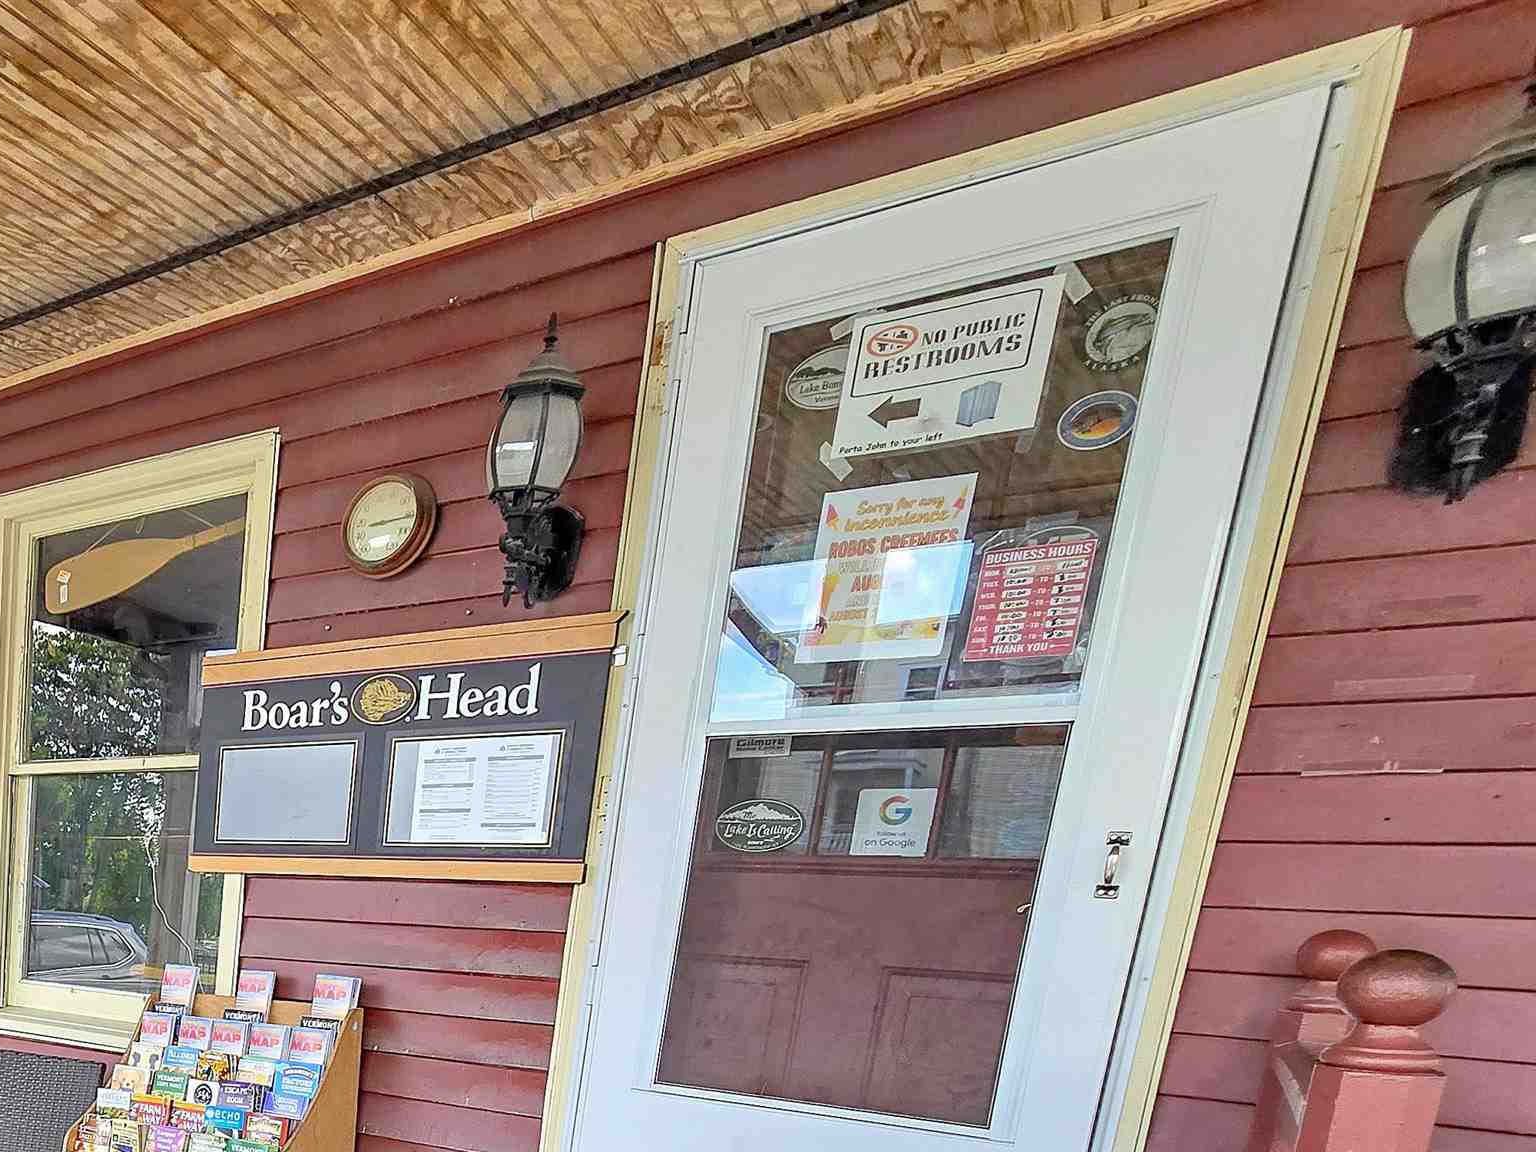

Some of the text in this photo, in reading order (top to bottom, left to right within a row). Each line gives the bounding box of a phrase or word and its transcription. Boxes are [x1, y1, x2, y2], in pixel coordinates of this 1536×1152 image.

[921, 312, 1026, 347] NO PUBLIC
[864, 334, 1023, 379] RESTROOMS
[839, 432, 944, 455] Porta John to your left
[856, 501, 894, 515] Sorry
[896, 497, 916, 510] for
[986, 548, 1045, 565] BUSINESS
[1048, 542, 1093, 558] HOURS
[851, 574, 881, 593] AUG
[989, 642, 1049, 655] THANK YOU
[241, 662, 543, 731] Boar's Head
[724, 823, 797, 841] Lake Is Calling
[879, 838, 917, 848] Google
[314, 988, 347, 1000] MAP
[291, 1039, 322, 1051] MAP
[138, 1103, 161, 1115] FARM
[181, 1110, 206, 1123] FARM
[143, 1112, 161, 1126] WAY
[184, 1120, 206, 1133] WAY
